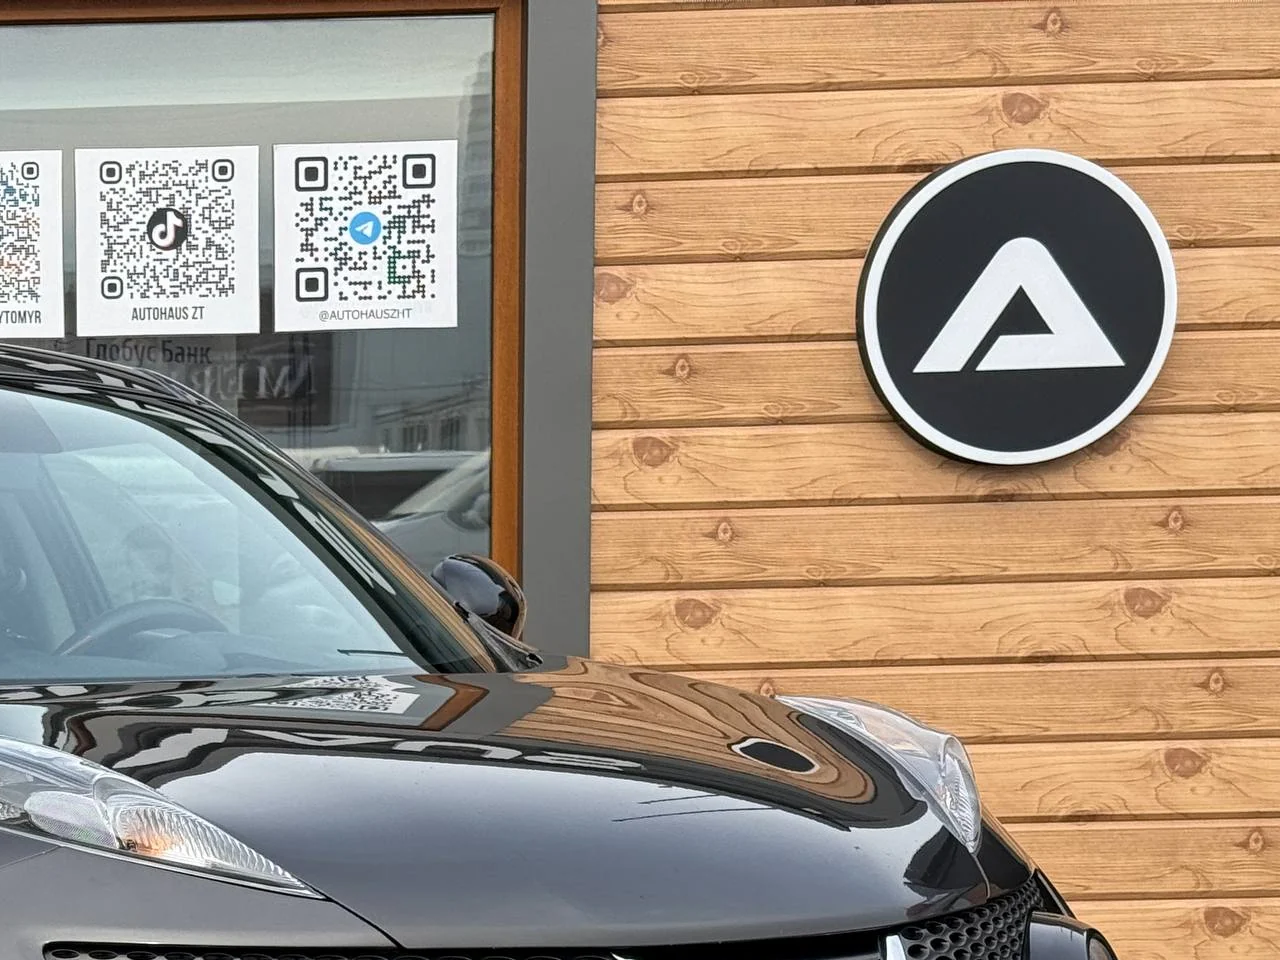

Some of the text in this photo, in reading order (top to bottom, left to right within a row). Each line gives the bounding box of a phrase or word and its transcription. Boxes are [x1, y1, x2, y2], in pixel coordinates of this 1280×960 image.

[131, 306, 205, 321] AUTOHAUS ZT
[319, 308, 413, 322] @AUTOHAUSZHT
[161, 339, 213, 365] Банк
